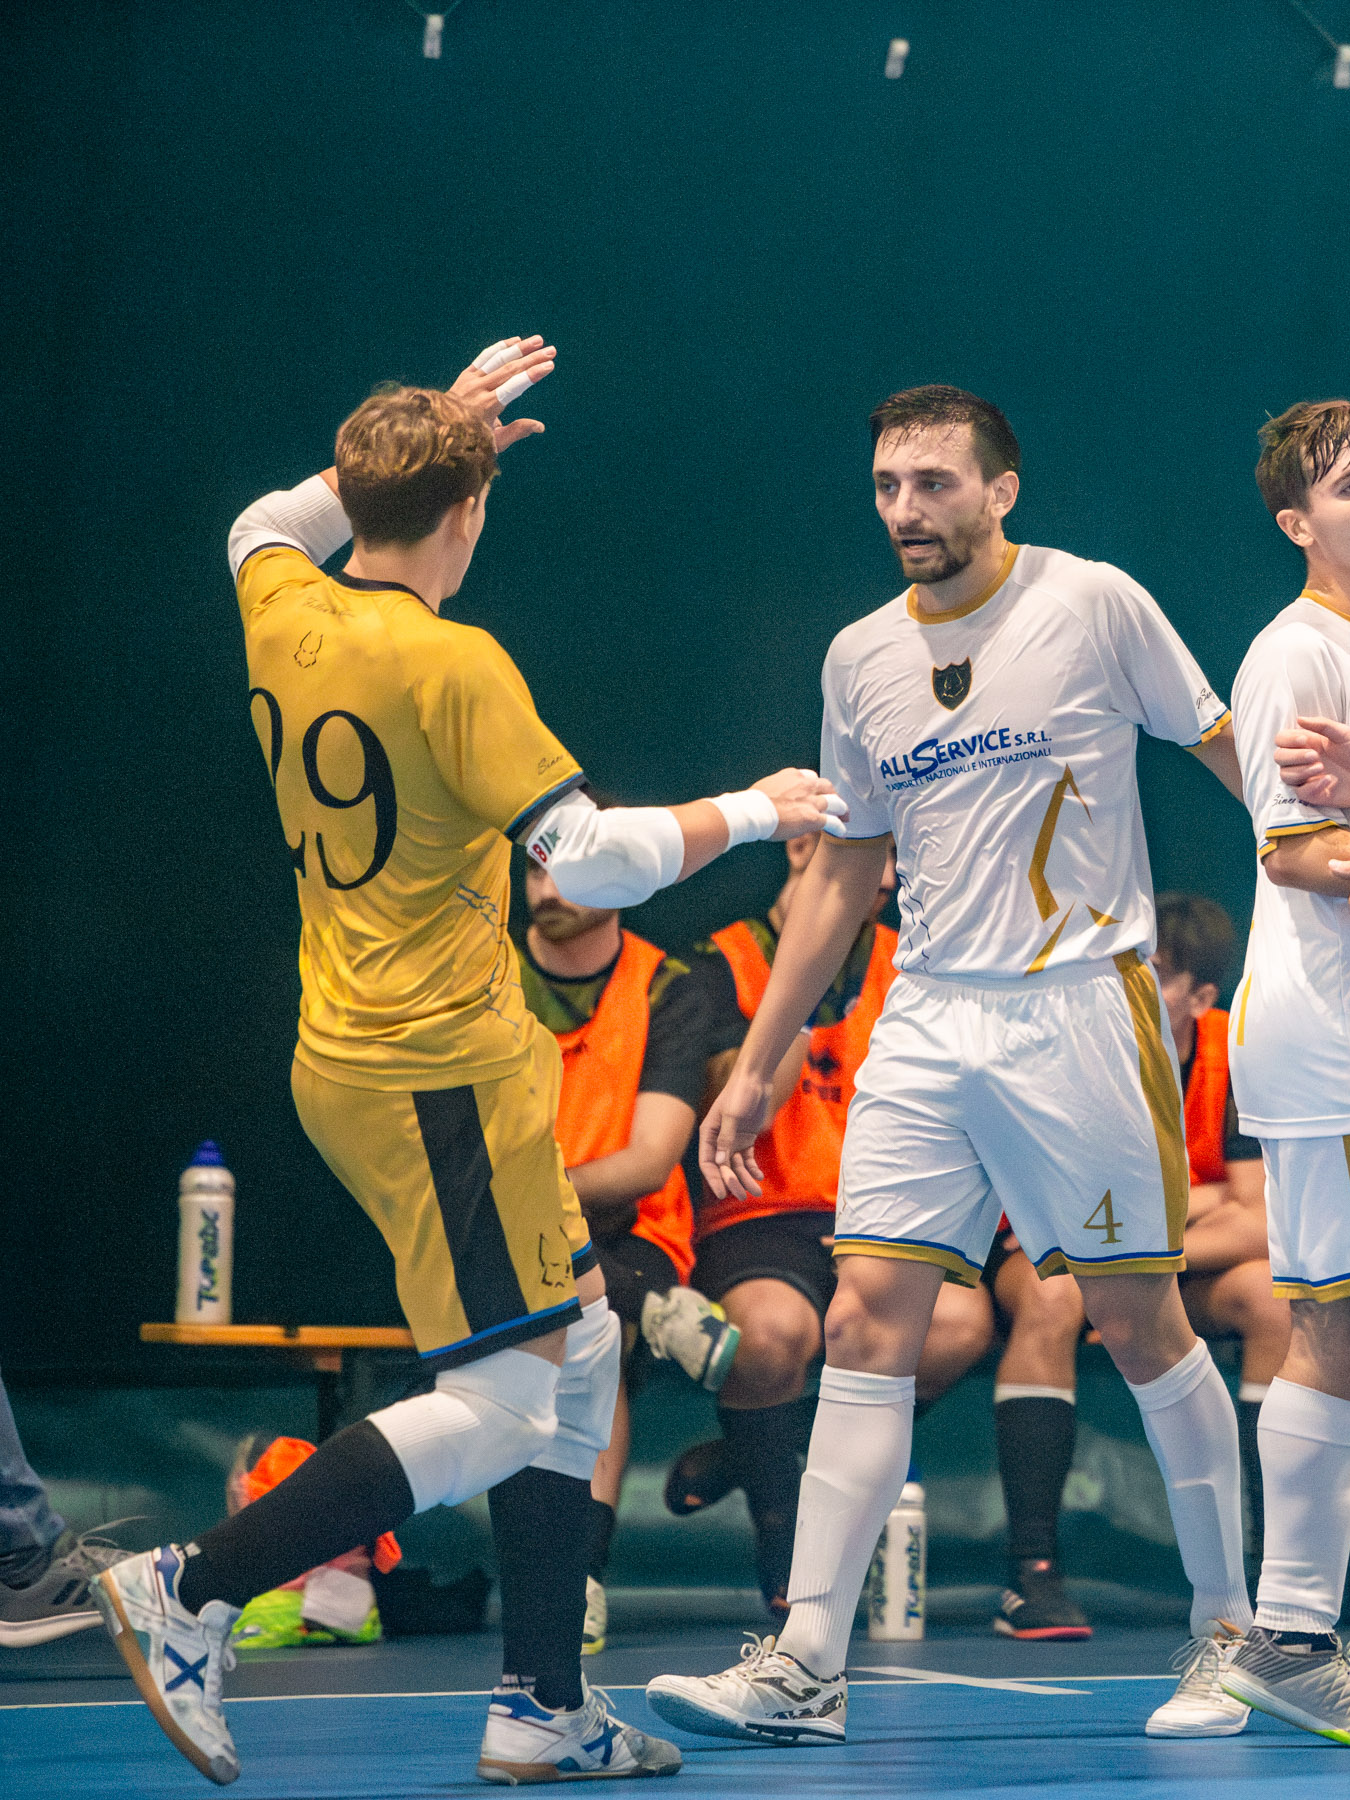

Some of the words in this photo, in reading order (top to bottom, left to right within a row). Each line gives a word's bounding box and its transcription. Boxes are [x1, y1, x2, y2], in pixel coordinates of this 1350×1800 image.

[880, 728, 1012, 779] ALLSERVICE
[1014, 730, 1053, 747] S.R.L.
[926, 762, 971, 783] NAZIONALI
[971, 762, 978, 772] E
[978, 747, 1052, 769] INTERNAZIONALI
[1083, 1188, 1124, 1245] 4
